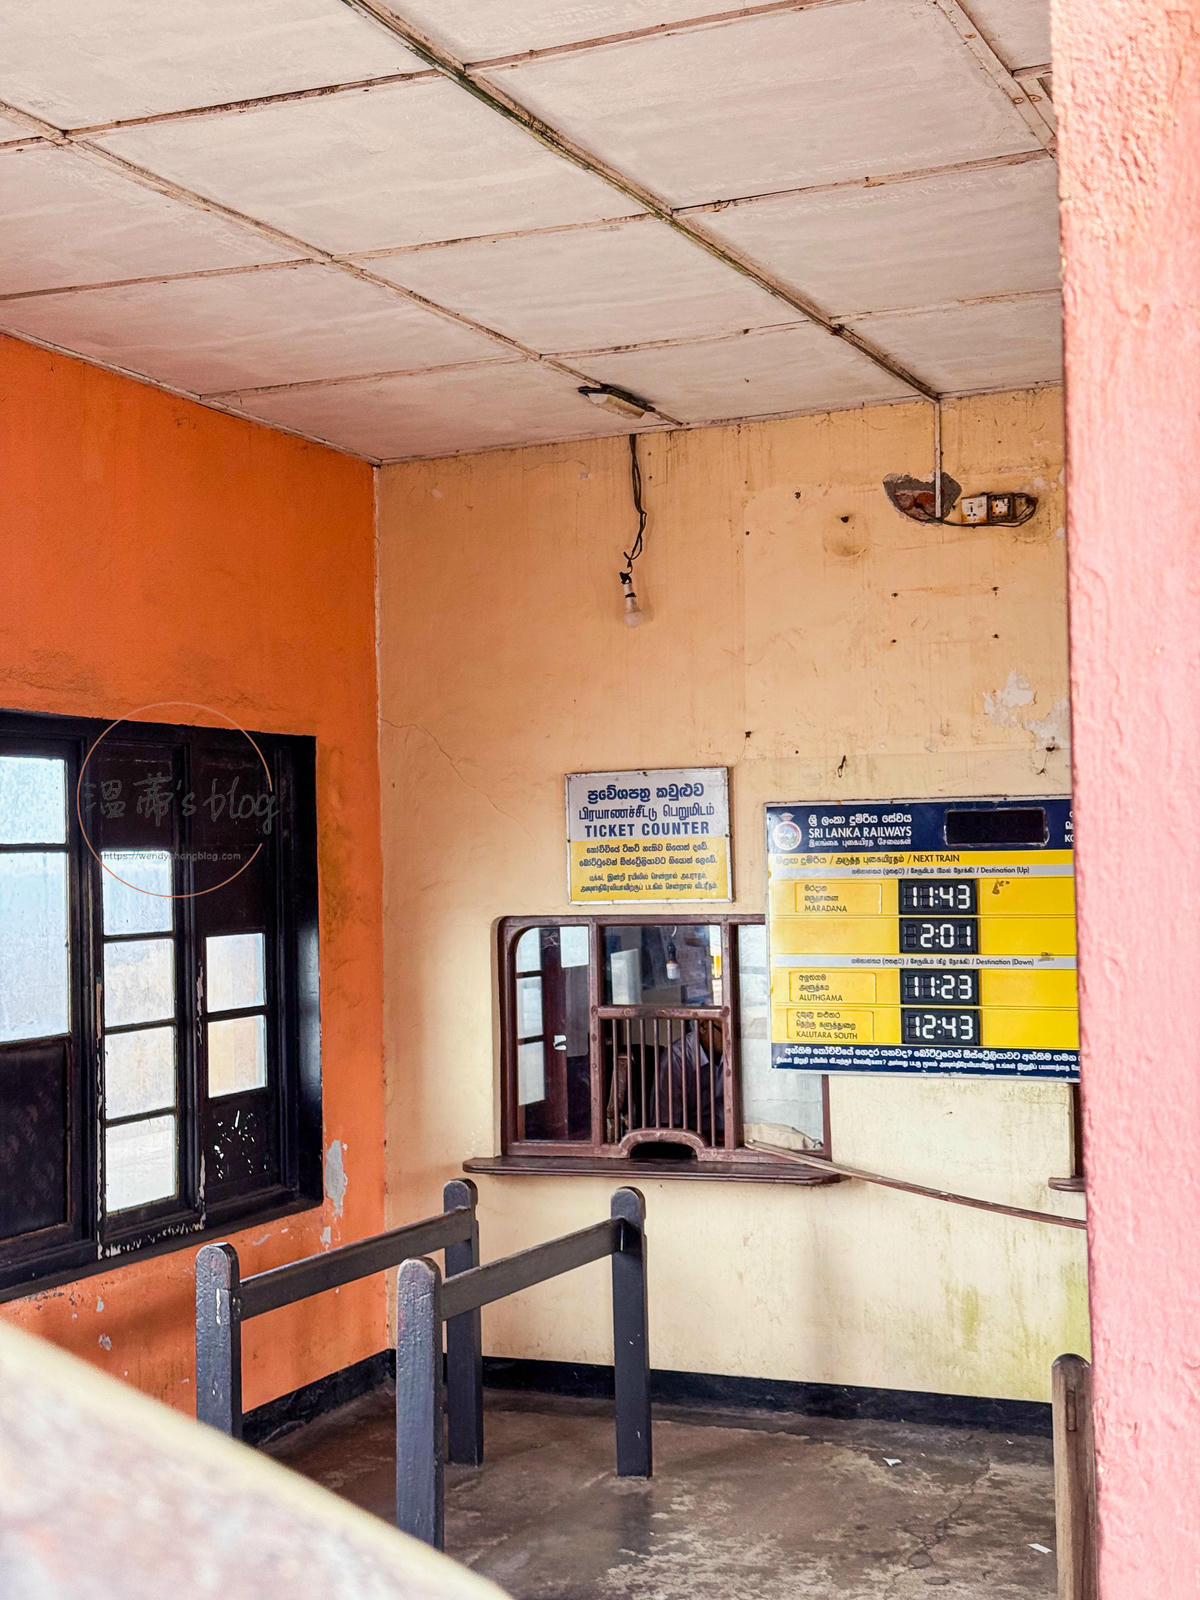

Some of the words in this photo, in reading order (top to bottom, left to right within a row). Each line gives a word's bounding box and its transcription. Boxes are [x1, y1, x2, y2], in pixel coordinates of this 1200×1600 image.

[656, 782, 704, 801] කවුළුව
[579, 805, 657, 821] பிரயாணச்சீட்டு
[663, 802, 714, 820] பெறுமிடம்
[822, 814, 845, 825] ලංකා
[849, 814, 878, 826] දුම්රිය
[882, 813, 912, 824] සේවය
[585, 824, 634, 837] TICKET
[642, 822, 709, 835] COUNTER
[809, 828, 822, 838] SRI
[826, 827, 860, 838] LANKA
[863, 826, 912, 837] RAILWAYS
[913, 855, 933, 863] NEXT
[935, 854, 960, 862] TRAIN
[913, 884, 970, 909] 11:43
[804, 904, 847, 912] MARADANA
[920, 924, 971, 948] 2:01
[1012, 958, 1034, 966] (Down)
[914, 975, 972, 999] 11:23
[915, 1015, 973, 1040] 12:43
